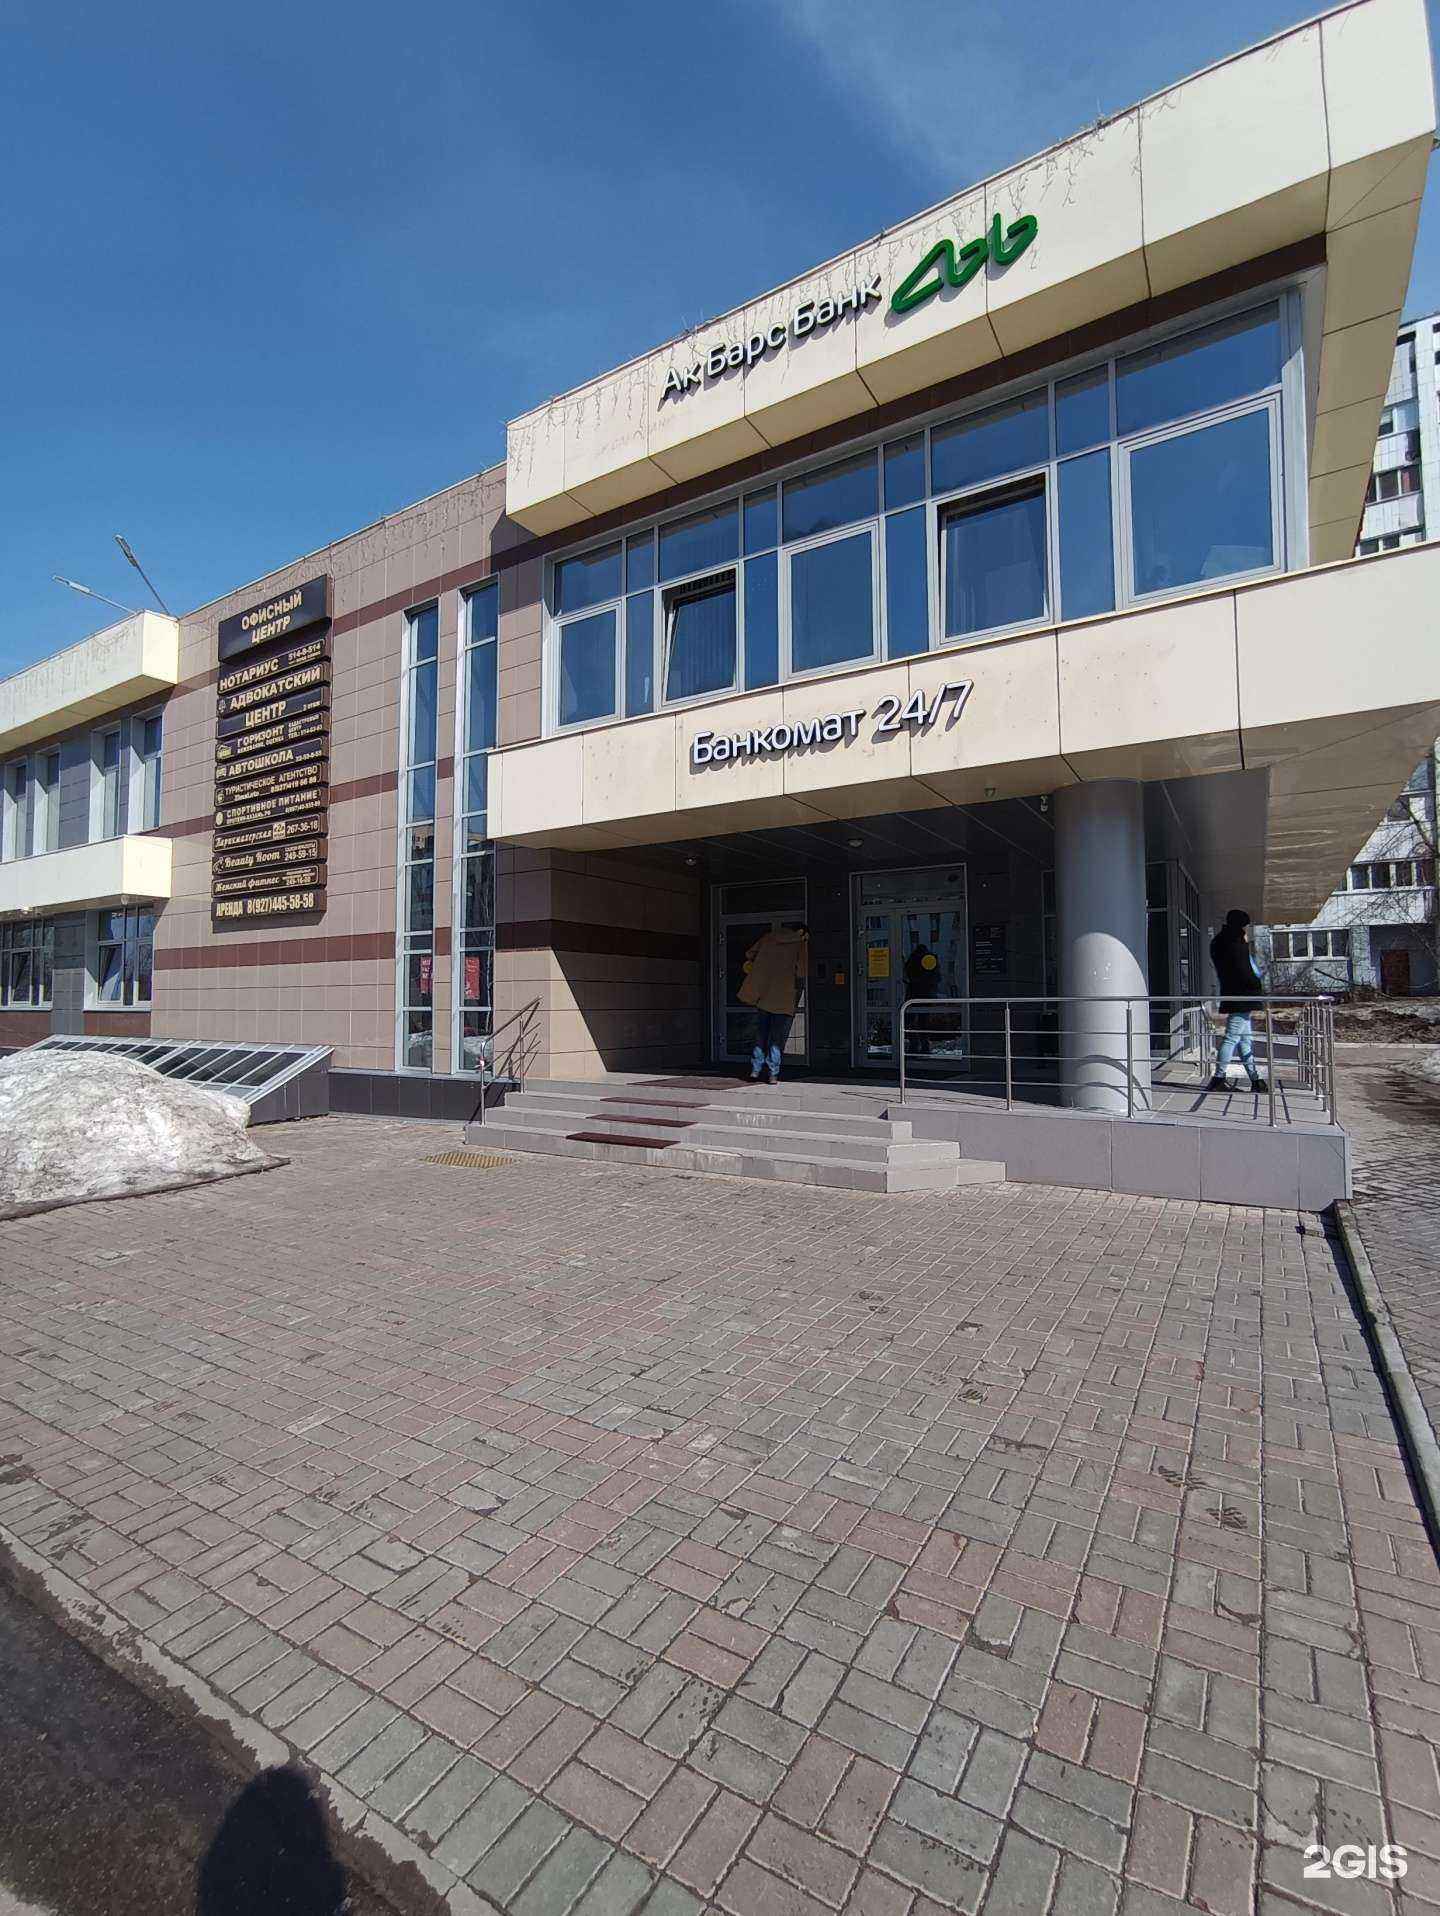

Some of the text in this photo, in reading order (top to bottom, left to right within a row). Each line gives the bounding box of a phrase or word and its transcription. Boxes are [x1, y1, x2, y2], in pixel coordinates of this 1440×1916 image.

[662, 274, 881, 399] Ак Барс Банк
[241, 589, 302, 630] ОФИСНЫЙ
[251, 615, 291, 645] ЦЕНТР
[219, 658, 279, 692] НОТАРИУС
[230, 665, 321, 711] АДВОКАТСКИЙ
[245, 700, 287, 729] ЦЕНТР
[692, 679, 974, 764] Банкомат 24/7
[237, 724, 285, 748] ГОРИЗОНТ
[228, 749, 294, 777] АВТОШКОЛА
[224, 776, 276, 797] ТУРИСТИЧЕСКОЕ
[278, 764, 318, 784] АГЕНТСТВО
[225, 800, 277, 819] СПОРТИВНОЕ
[277, 788, 318, 807] ПИТАНИЕ
[214, 829, 273, 849] Парикмахерская
[286, 820, 318, 835] 267-36-18
[224, 850, 281, 869] Beauty Room
[215, 880, 247, 893] Женский
[247, 876, 280, 889] фитнес
[215, 900, 244, 918] АРЕНДА
